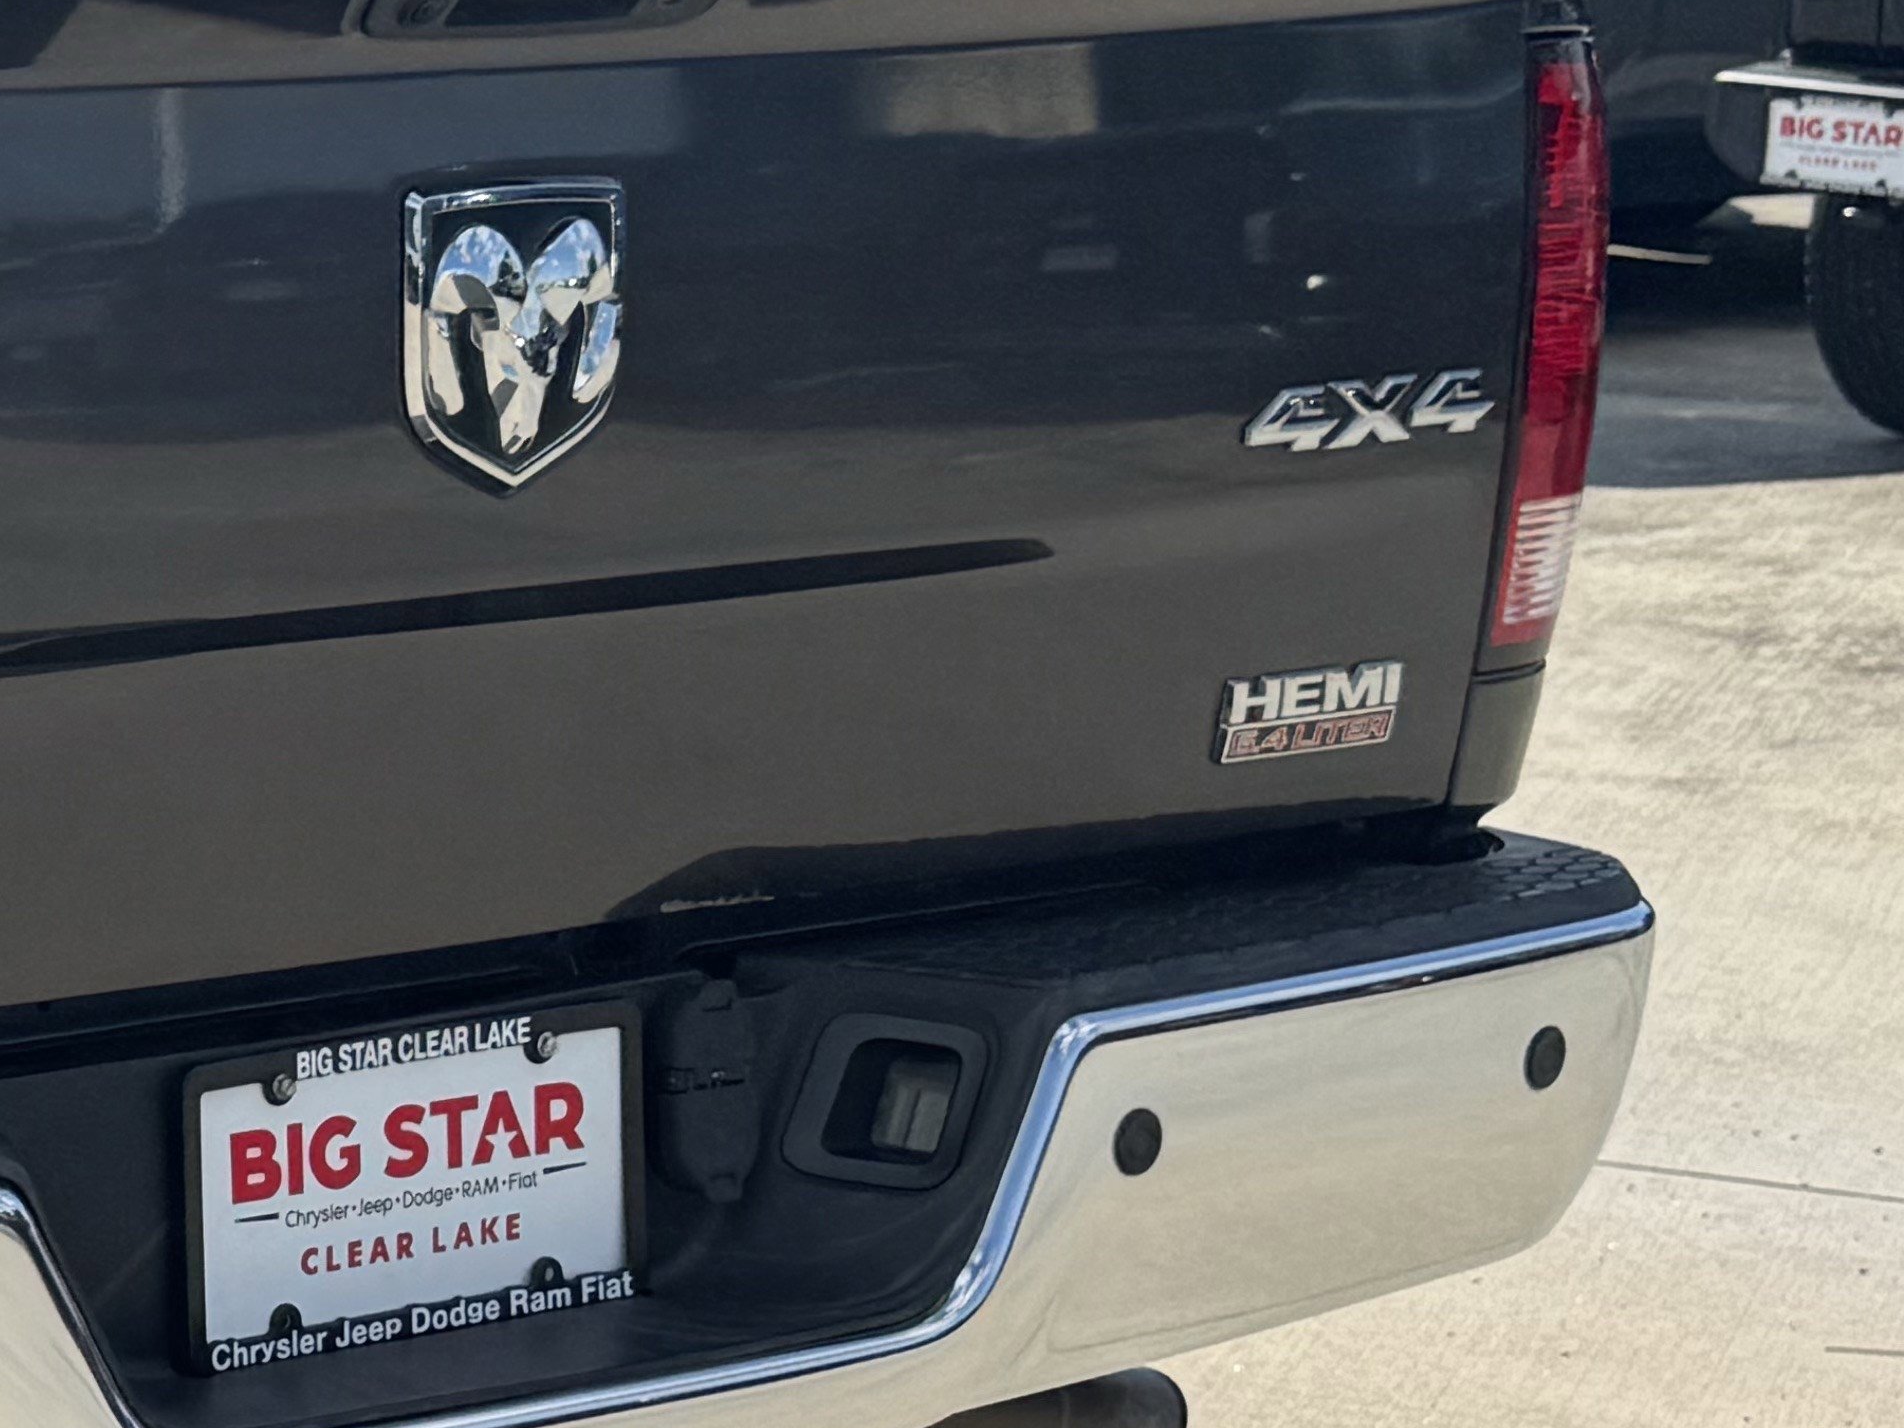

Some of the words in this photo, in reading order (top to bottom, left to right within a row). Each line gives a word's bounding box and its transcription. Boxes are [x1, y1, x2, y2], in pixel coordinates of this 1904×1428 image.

[1780, 116, 1824, 141] BIG
[1831, 119, 1904, 148] STAR
[1242, 367, 1495, 452] 4X4
[1224, 661, 1403, 725] HEMI
[1293, 713, 1388, 750] LITER
[296, 1046, 333, 1080] BIG
[338, 1037, 393, 1072] STAR
[398, 1025, 469, 1062] CLEAR
[475, 1016, 532, 1050] LAKE
[229, 1114, 362, 1205] BIG
[383, 1081, 586, 1179] STAR
[300, 1230, 414, 1276] CLEAR
[433, 1212, 522, 1255] LAKE
[211, 1329, 328, 1372] Chrysler
[335, 1316, 403, 1349] Jeep
[410, 1299, 501, 1335] Dodge
[509, 1285, 572, 1317] Ram
[581, 1270, 634, 1304] Fiat
